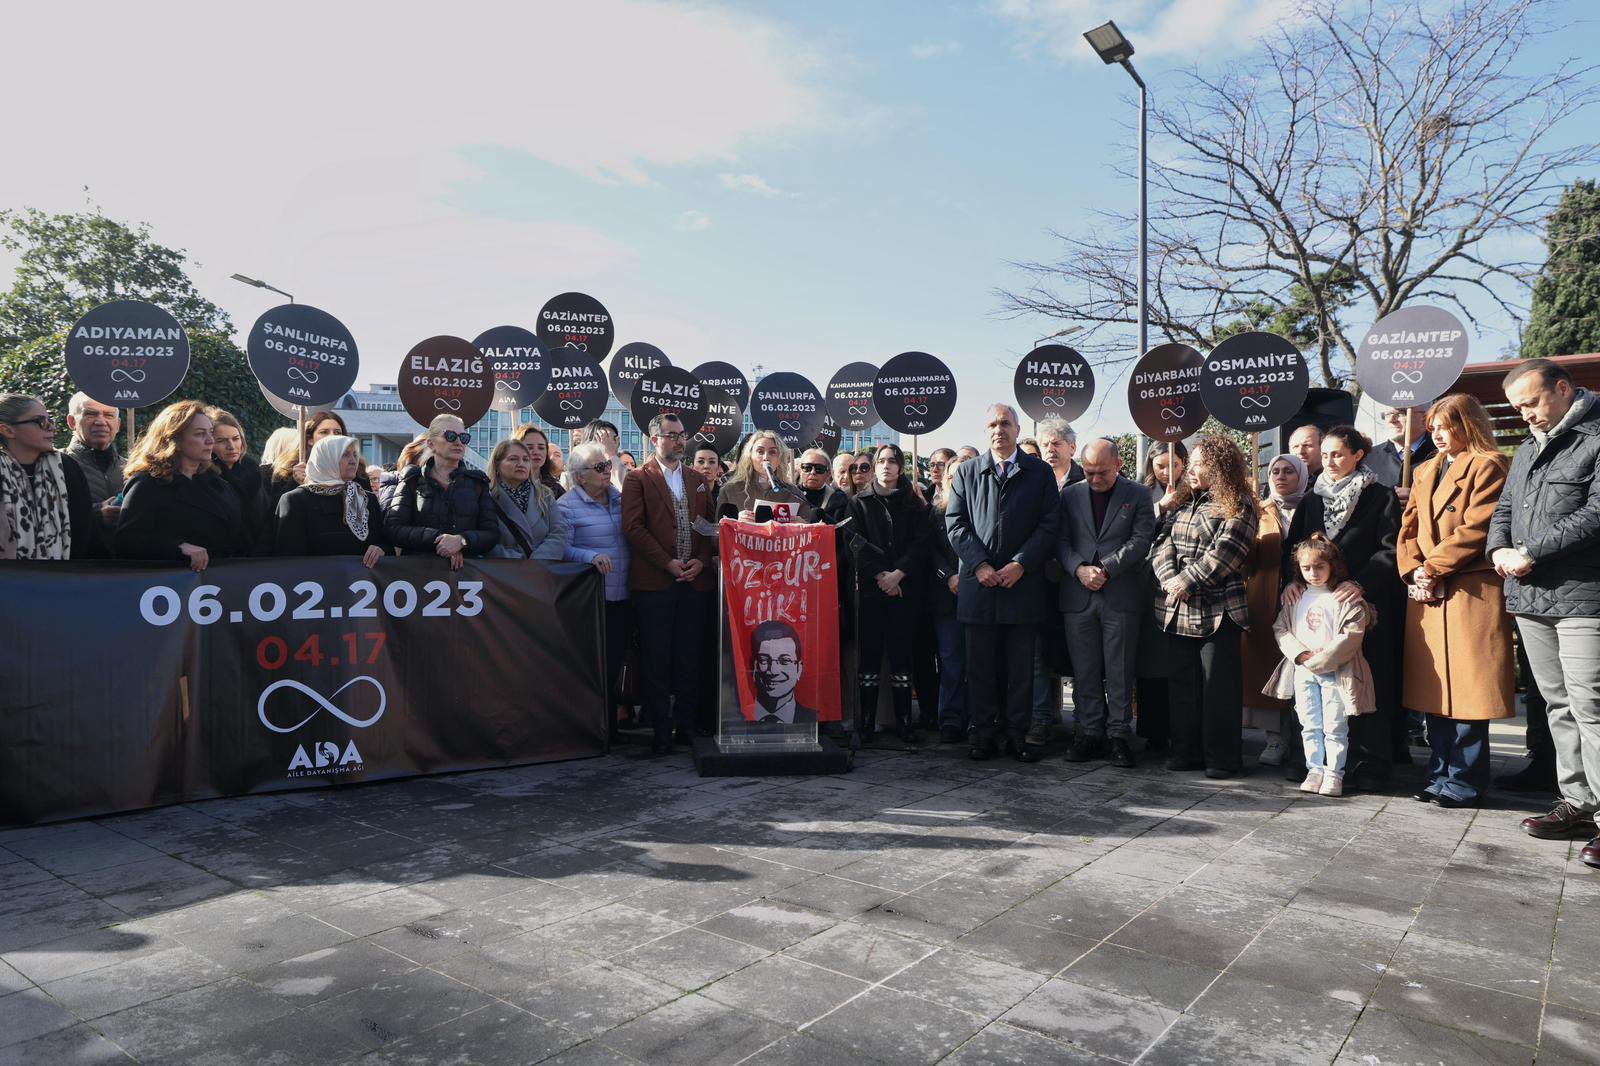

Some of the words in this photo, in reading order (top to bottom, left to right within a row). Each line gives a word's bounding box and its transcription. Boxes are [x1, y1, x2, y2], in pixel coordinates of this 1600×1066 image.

[542, 310, 609, 323] GAZİANTEP
[75, 326, 181, 340] ADIYAMAN
[547, 324, 605, 335] 06.02.2023
[263, 322, 348, 351] ŞANLIURFA
[1367, 330, 1462, 345] GAZİANTEP
[83, 345, 174, 357] 06.02.2023
[264, 339, 346, 366] 06.02.2023
[1371, 347, 1454, 360] 06.02.2023
[111, 358, 147, 368] 04.17
[288, 356, 321, 369] 04.17
[411, 355, 483, 374] ELAZIĞ
[491, 362, 541, 370] .02.2023
[624, 355, 661, 370] KİLİS
[1027, 361, 1083, 376] HATAY
[1208, 353, 1298, 372] OSMANİYE
[1393, 360, 1425, 369] 04.17
[551, 367, 593, 378] DANA
[1215, 371, 1295, 387] 06.02.2023
[412, 376, 483, 389] 06.02.2023
[546, 381, 599, 391] 6.02.2023
[700, 378, 743, 386] ARBAKIR
[878, 375, 950, 384] KAHRAMANMARAŞ
[1025, 378, 1085, 388] 06.02.2023
[434, 388, 462, 398] 04.17
[641, 380, 700, 399] ELAZIĞ
[758, 391, 816, 400] ŞANLIURFA
[834, 391, 873, 399] 06.02.20
[884, 386, 946, 396] 06.02.2023
[1043, 388, 1067, 396] 04.17
[1239, 385, 1272, 396] 04.17
[641, 396, 699, 410] 06.02.2023
[1160, 396, 1185, 407] 04.17
[709, 403, 737, 414] NİYE
[730, 549, 831, 589] ÖZGÜR-
[139, 580, 484, 626] 06.02.2023
[744, 589, 807, 626] LÜK!
[256, 632, 387, 670] 04.17
[287, 739, 364, 771] ADA
